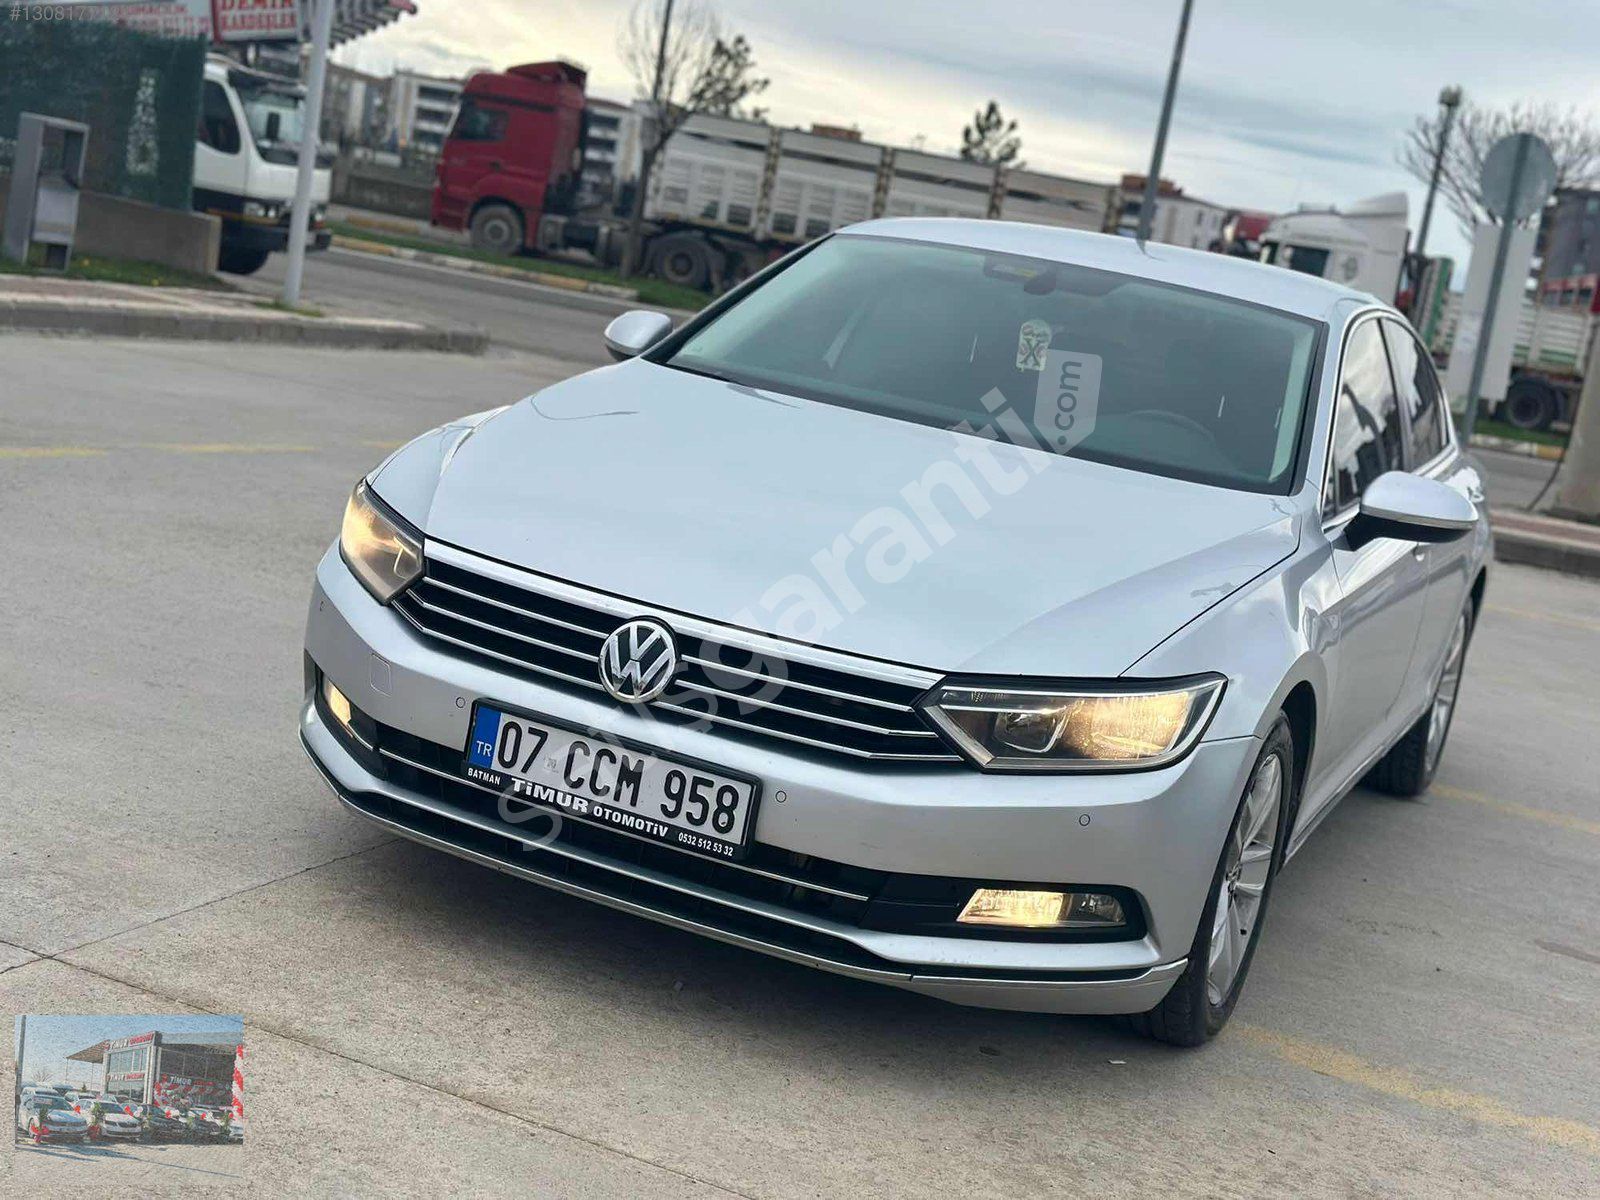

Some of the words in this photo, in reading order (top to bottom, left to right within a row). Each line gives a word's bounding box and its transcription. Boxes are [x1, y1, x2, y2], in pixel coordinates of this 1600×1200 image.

[467, 767, 501, 785] BATMAN
[678, 832, 697, 846] 0532
[697, 839, 712, 850] 512
[712, 844, 723, 853] 53
[723, 846, 734, 857] 32
[476, 740, 493, 757] TR
[497, 721, 548, 774] 07
[563, 740, 644, 807] CCM
[660, 769, 740, 834] 958
